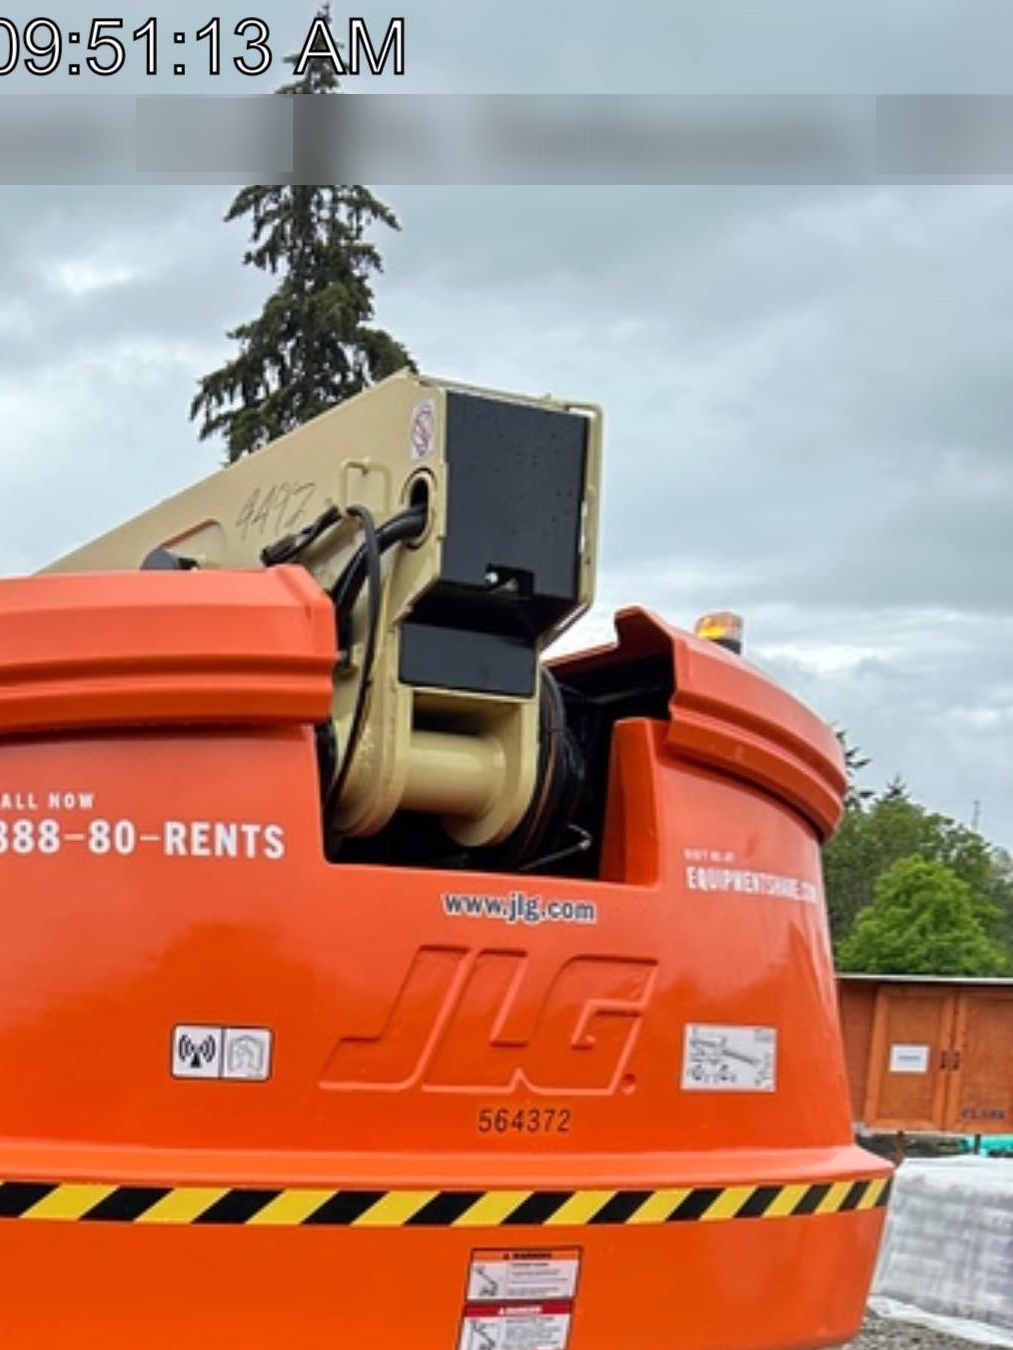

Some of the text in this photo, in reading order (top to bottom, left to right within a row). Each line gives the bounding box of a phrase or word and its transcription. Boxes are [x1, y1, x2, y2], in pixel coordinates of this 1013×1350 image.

[48, 793, 95, 809] NOW
[444, 892, 596, 922] www.jlg.com
[319, 945, 658, 1095] JLG
[477, 1108, 572, 1133] 564372
